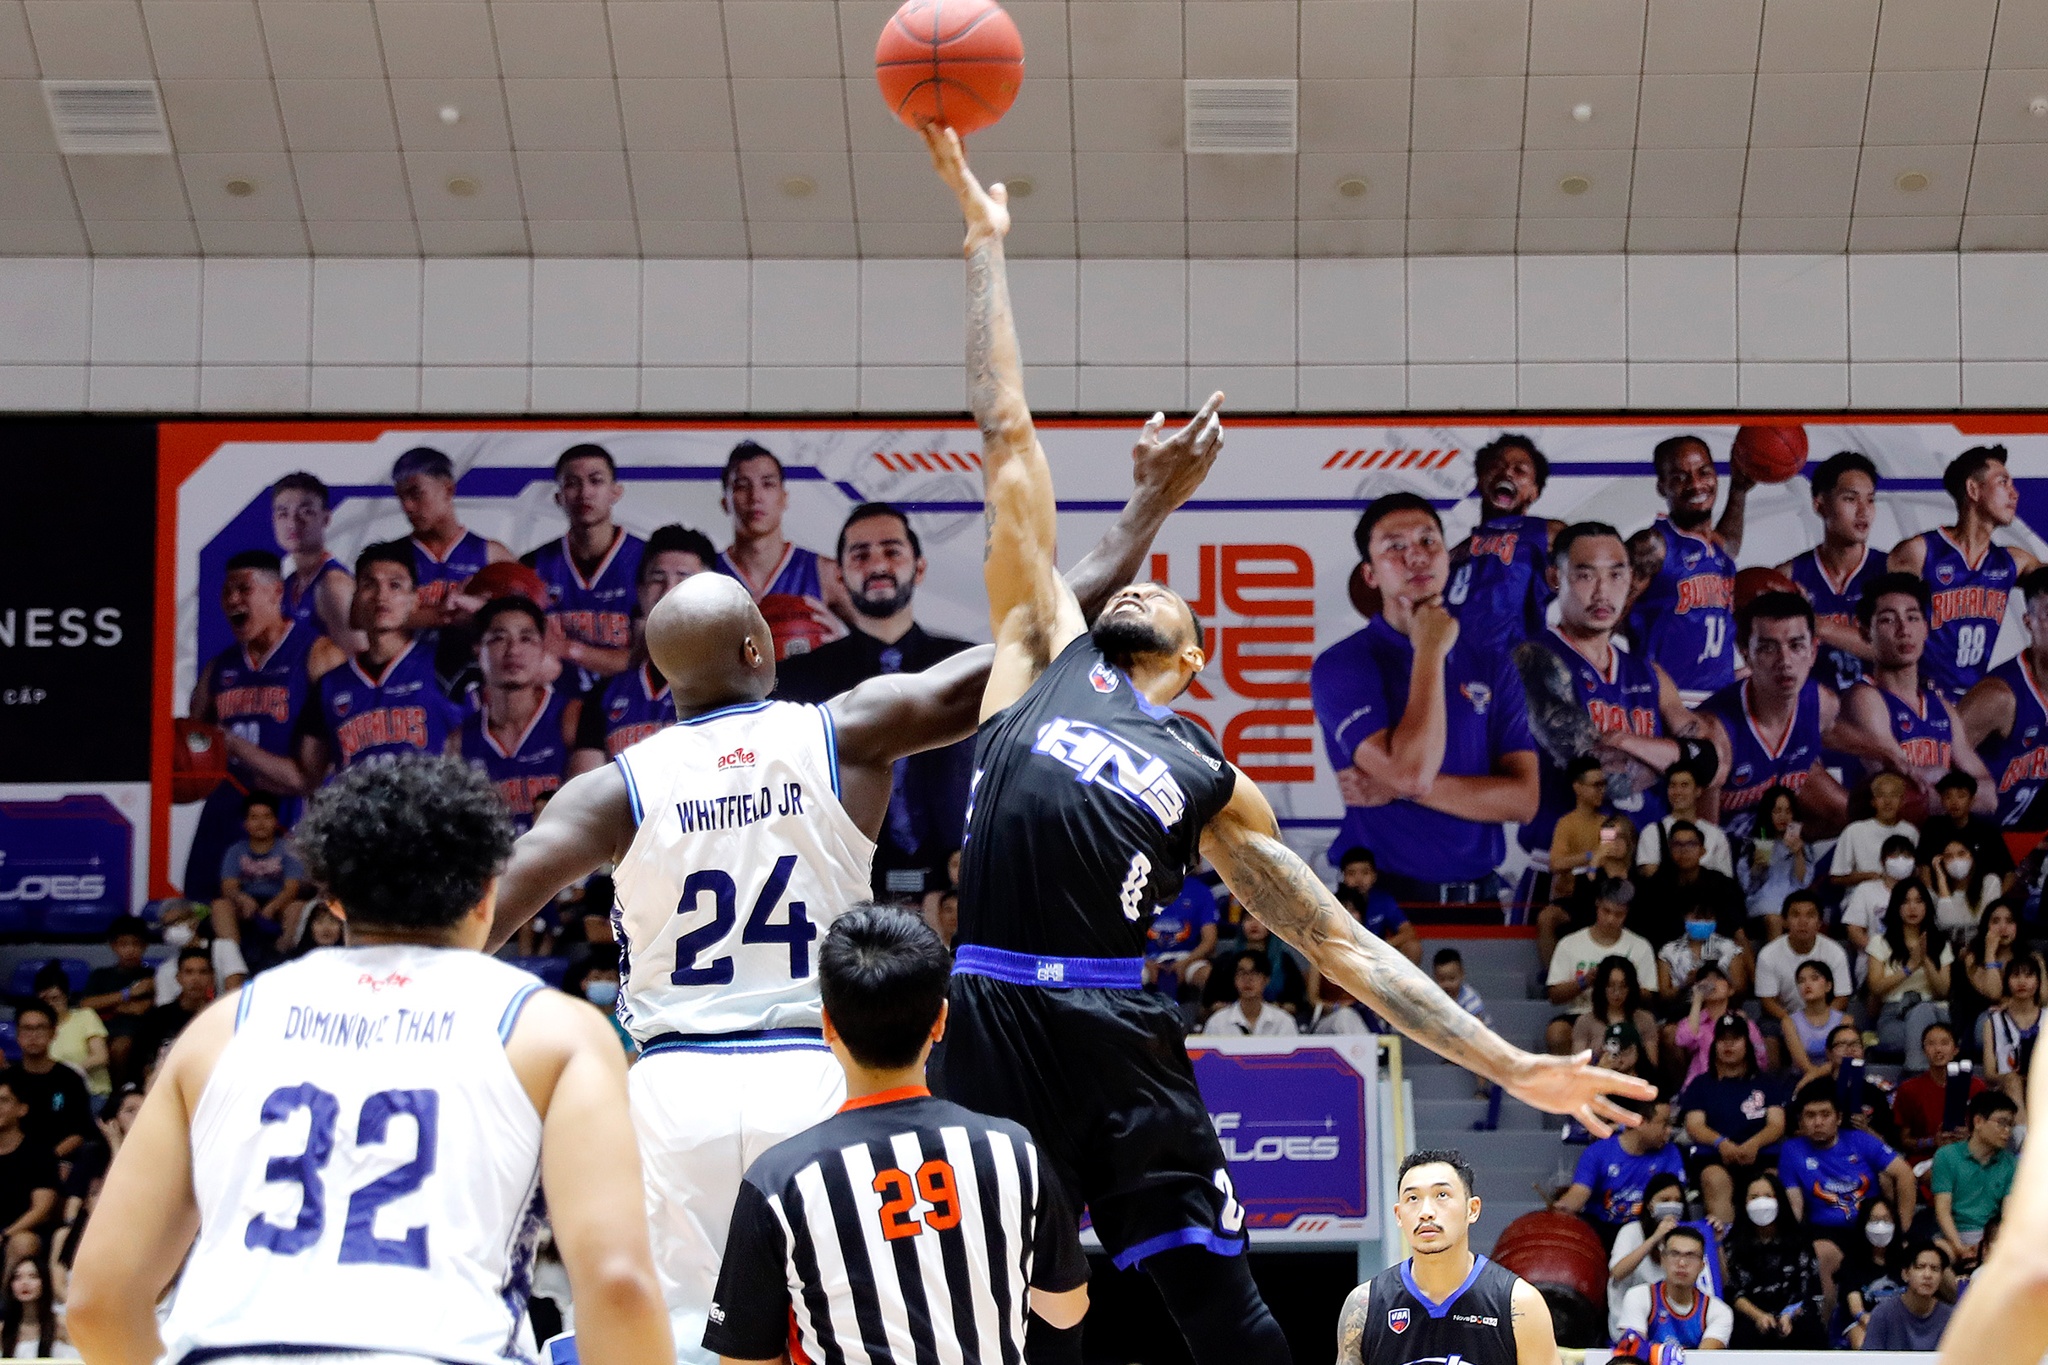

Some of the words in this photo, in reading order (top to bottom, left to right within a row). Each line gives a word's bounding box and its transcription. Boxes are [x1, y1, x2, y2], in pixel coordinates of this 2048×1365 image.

[1956, 624, 1987, 668] 88
[676, 786, 772, 834] WHITFIELD
[778, 782, 805, 817] JR
[671, 855, 817, 986] 24
[395, 1008, 456, 1044] THAM
[244, 1081, 440, 1270] 32
[872, 1158, 963, 1242] 29
[1391, 1310, 1408, 1322] VBA
